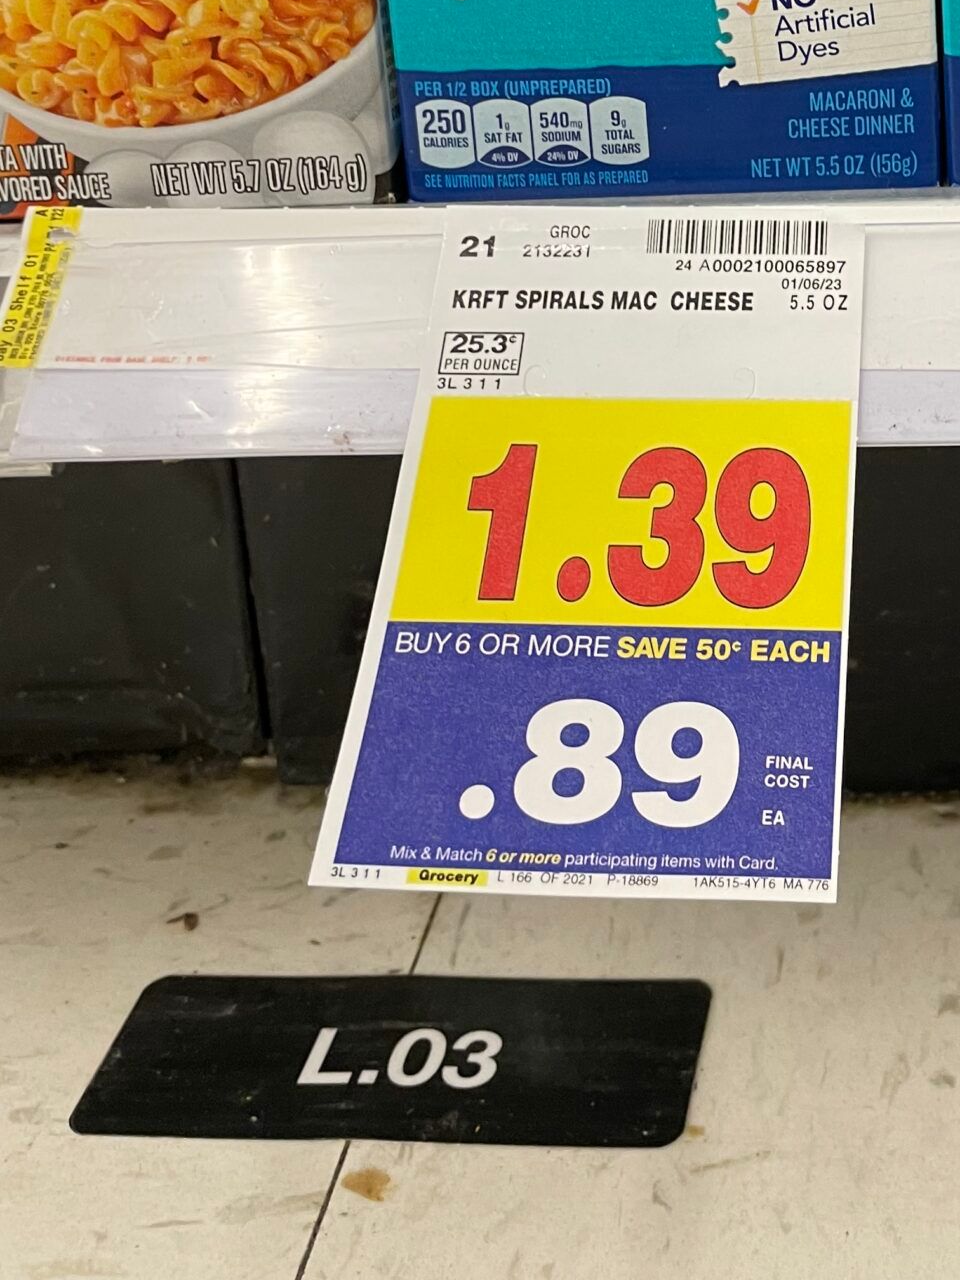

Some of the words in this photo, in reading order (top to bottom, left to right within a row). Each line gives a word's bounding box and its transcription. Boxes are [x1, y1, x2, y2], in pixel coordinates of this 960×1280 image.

[774, 4, 876, 36] Artificial
[777, 39, 840, 66] Dyes
[415, 80, 442, 97] PER
[448, 82, 467, 96] 1/2
[472, 81, 498, 96] BOX
[505, 78, 611, 99] (UNPREPARED)
[810, 88, 895, 111] MACARONI
[901, 88, 913, 108] &
[422, 109, 466, 134] 250
[789, 117, 849, 138] CHEESE
[855, 114, 914, 136] DINNER
[423, 137, 469, 148] CALORIES
[484, 133, 502, 144] SAT
[506, 132, 522, 143] FAT
[542, 132, 581, 142] SODIUM
[605, 129, 635, 141] TOTAL
[19, 144, 67, 170] WITH
[601, 144, 641, 155] SUGARS
[751, 158, 781, 178] NET
[786, 157, 811, 176] WT
[816, 155, 839, 175] 5.5
[844, 155, 865, 175] OZ
[871, 151, 917, 177] (156g)
[151, 163, 189, 196] NET
[191, 161, 226, 194] WT
[232, 159, 260, 192] 5.7
[268, 159, 295, 191] OZ
[425, 174, 442, 188] SEE
[445, 174, 494, 188] NUTRITION
[497, 173, 526, 187] FACTS
[530, 172, 556, 186] PANEL
[561, 172, 581, 185] FOR
[583, 172, 596, 185] AS
[599, 170, 649, 184] PREPARED
[55, 174, 110, 200] SAUCE
[550, 225, 590, 238] GROC
[460, 235, 496, 257] 21
[676, 260, 692, 271] 24
[782, 278, 842, 290] 01/06/23
[10, 276, 31, 311] Shelf
[453, 290, 508, 308] KRFT
[515, 290, 604, 309] SPIRALS
[612, 290, 658, 311] MAC
[671, 291, 753, 311] CHEESE
[790, 295, 815, 310] 5.5
[823, 294, 848, 310] OZ
[444, 358, 468, 369] PER
[474, 359, 517, 370] OUNCE
[437, 378, 457, 389] 3L
[463, 378, 472, 389] 3
[467, 443, 811, 609] 1.39
[395, 633, 451, 654] BUY
[455, 634, 471, 654] 6
[479, 634, 519, 655] OR
[528, 635, 611, 657] MORE
[617, 637, 686, 659] SAVE
[750, 641, 830, 663] EACH
[459, 698, 740, 828] .89
[766, 756, 814, 771] FINAL
[765, 775, 810, 789] COST
[761, 811, 785, 825] EA
[390, 845, 417, 860] Mix
[420, 847, 432, 860] &
[435, 848, 482, 862] Match
[486, 848, 497, 862] 6
[499, 852, 516, 863] or
[519, 854, 561, 864] more
[565, 852, 657, 870] participating
[661, 854, 701, 868] items
[705, 855, 734, 869] with
[739, 856, 778, 870] Card.
[330, 867, 346, 877] 3L
[419, 870, 478, 884] Grocery
[511, 872, 532, 883] 166
[563, 874, 593, 886] 2021
[607, 875, 658, 887] P-18869
[783, 880, 803, 890] MA
[808, 880, 829, 890] 776
[296, 1027, 502, 1089] L.03
